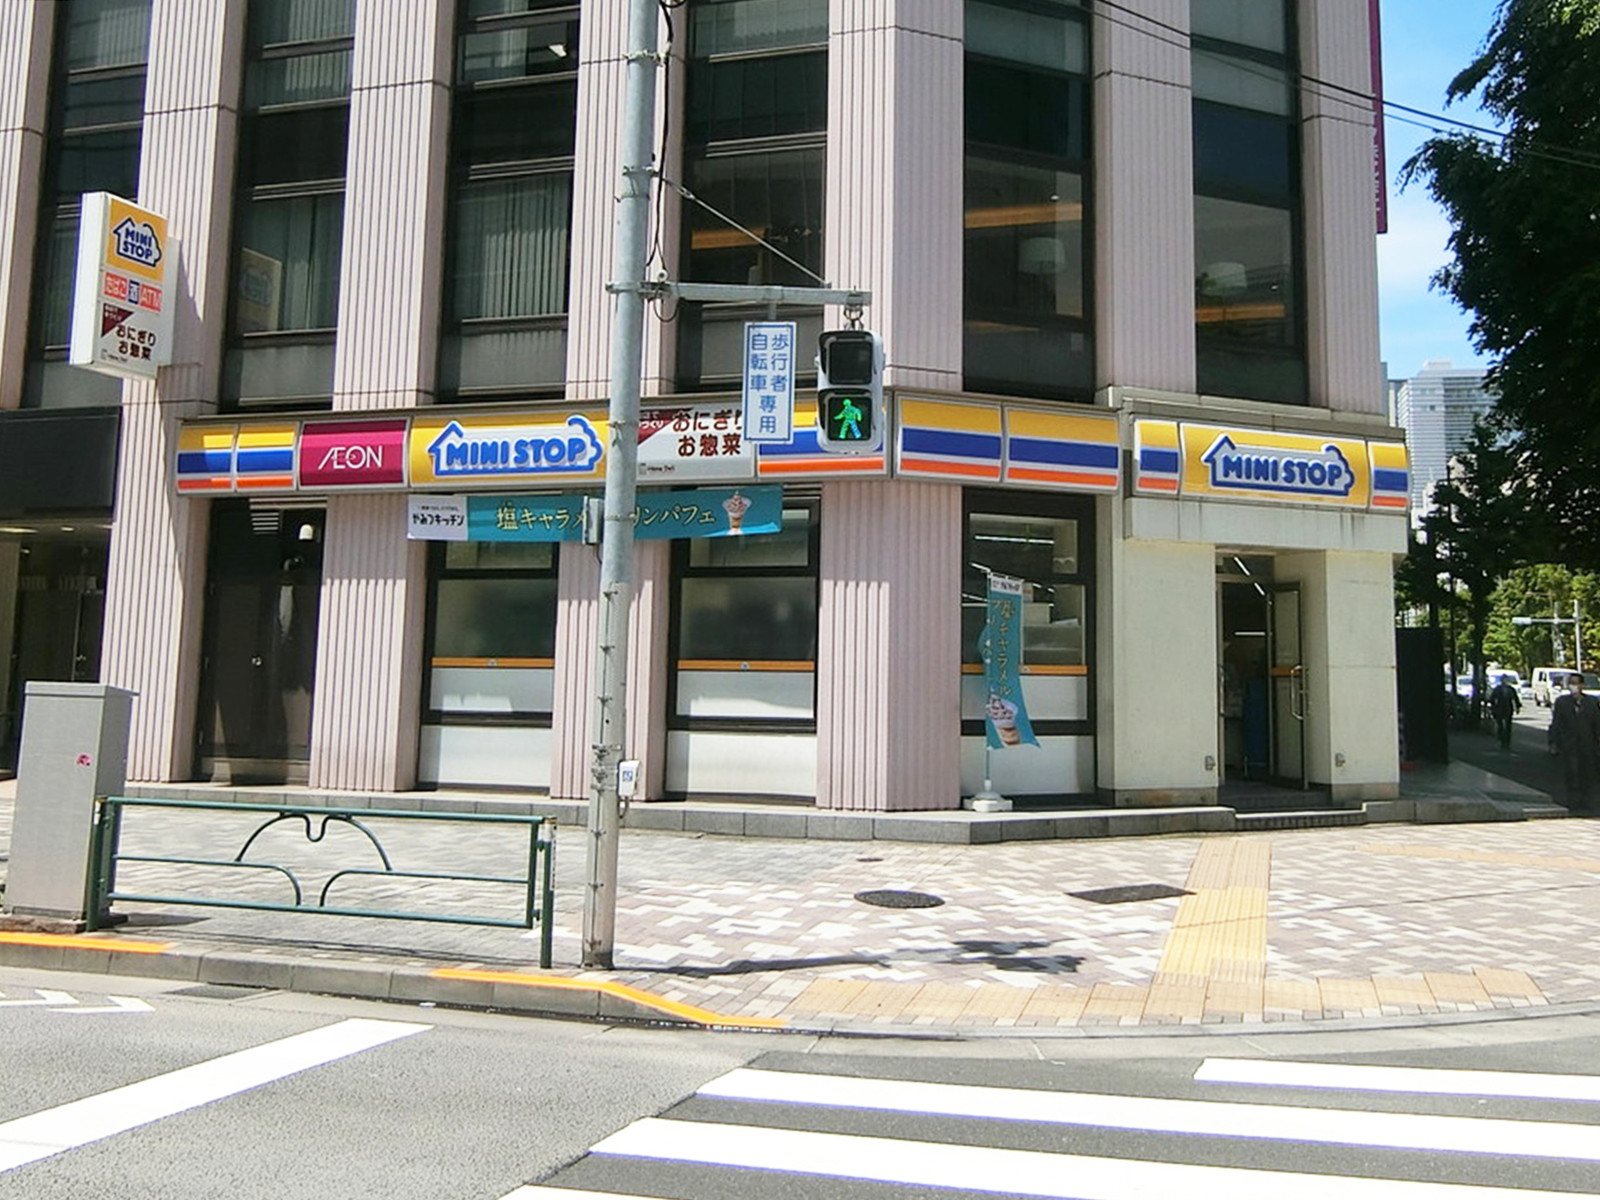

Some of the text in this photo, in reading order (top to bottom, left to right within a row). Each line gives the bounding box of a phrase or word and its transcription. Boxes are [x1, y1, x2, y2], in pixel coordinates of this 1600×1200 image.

[122, 241, 153, 260] STOP
[125, 228, 152, 247] MINI
[141, 287, 162, 310] ATM
[116, 324, 156, 347] おにぎり
[749, 333, 768, 392] 自転車
[771, 333, 790, 392] 歩行者
[758, 394, 777, 434] 専用
[446, 438, 587, 466] MINI STOP
[678, 433, 742, 457] お惣菜
[1222, 454, 1343, 487] MINI STOP
